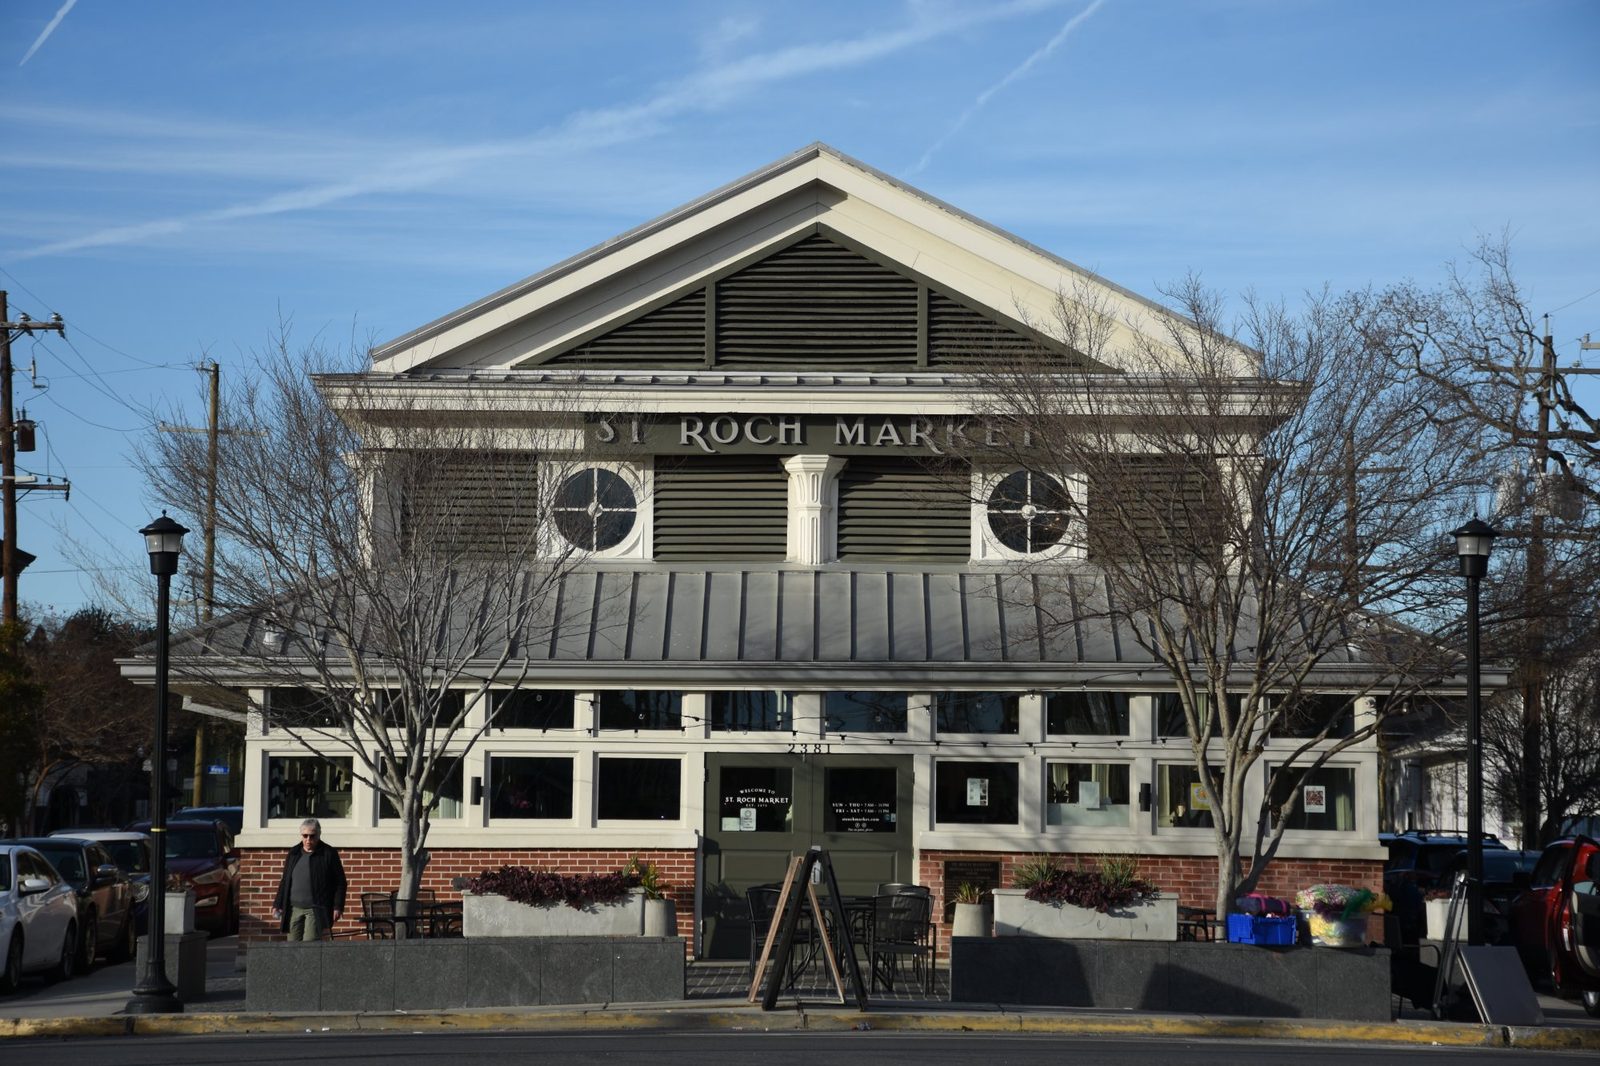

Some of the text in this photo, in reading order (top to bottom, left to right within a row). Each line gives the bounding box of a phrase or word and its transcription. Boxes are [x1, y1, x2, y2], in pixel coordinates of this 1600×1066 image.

[679, 415, 803, 453] ROCH
[787, 743, 831, 755] 2381
[736, 796, 756, 804] ROCH
